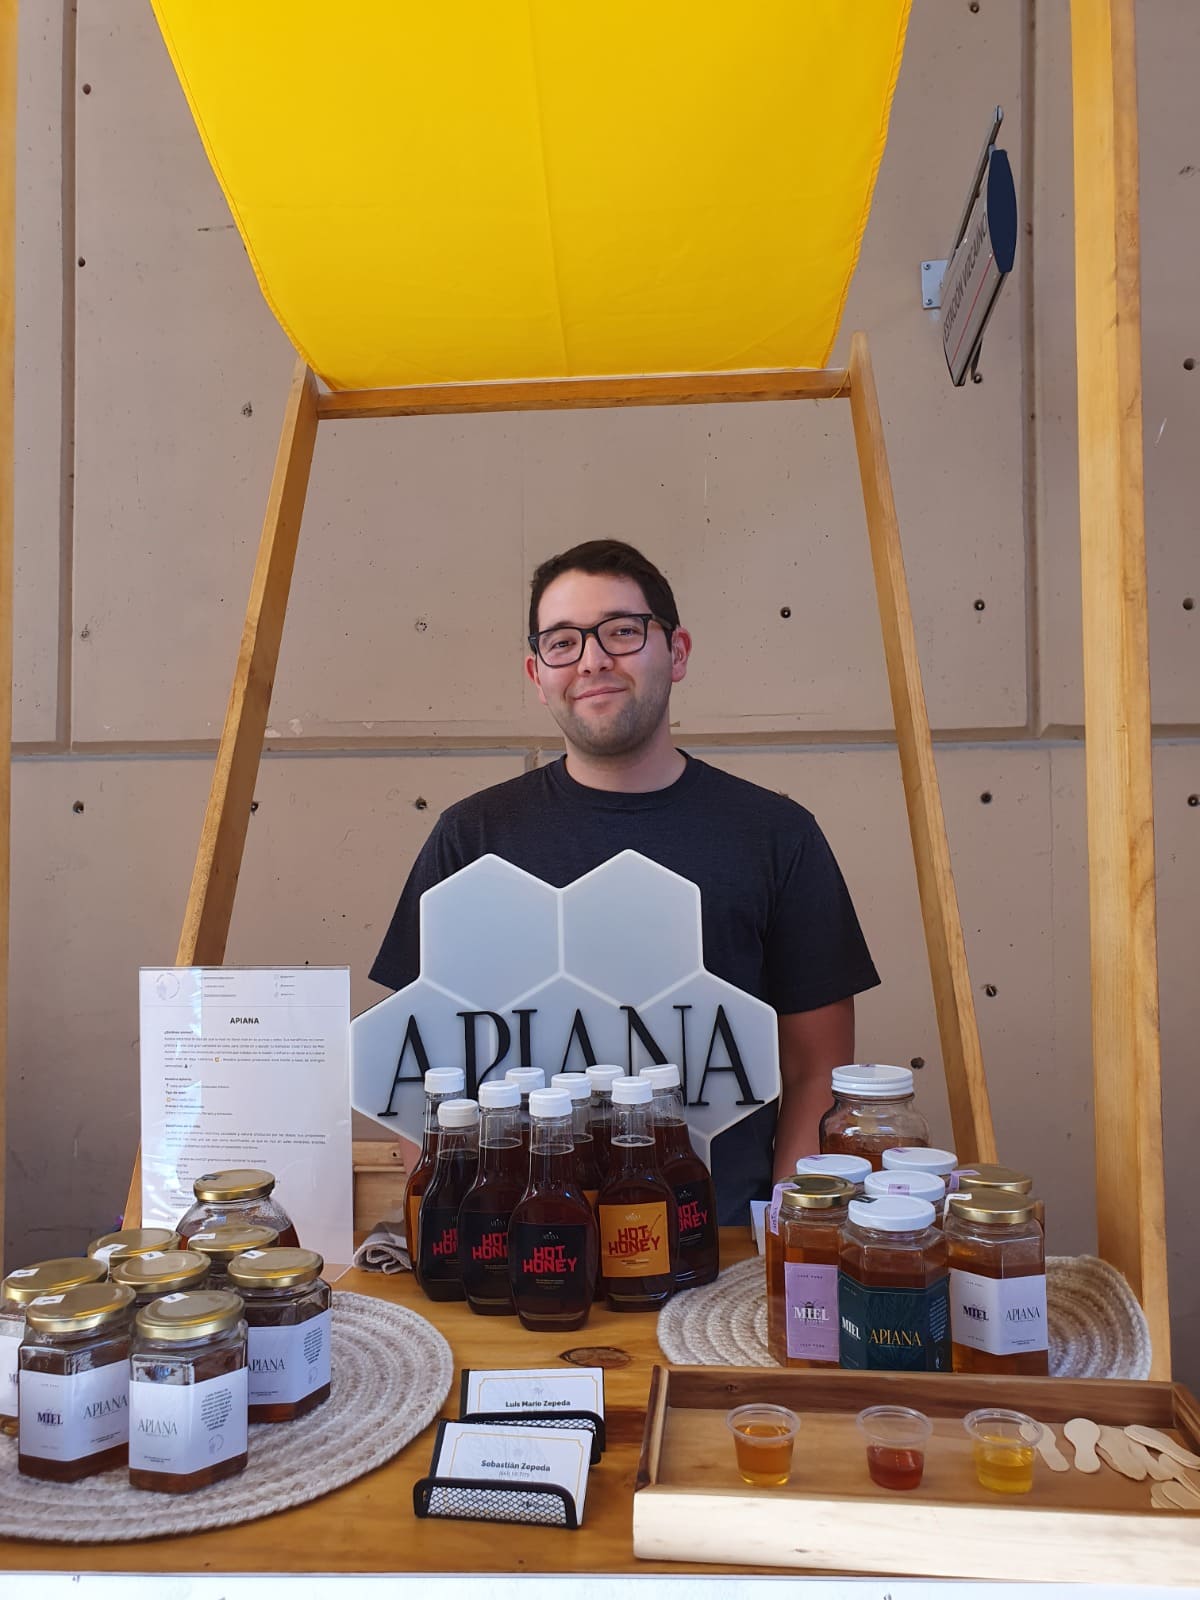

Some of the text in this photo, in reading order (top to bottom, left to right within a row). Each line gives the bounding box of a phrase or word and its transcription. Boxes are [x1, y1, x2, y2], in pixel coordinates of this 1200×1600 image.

[229, 1017, 260, 1025] APIANA
[377, 1004, 765, 1116] APIANA
[617, 1224, 649, 1242] HOT
[472, 1245, 509, 1260] HON
[532, 1245, 567, 1261] HOT
[608, 1236, 661, 1256] HONEY
[522, 1257, 577, 1274] HONEY
[794, 1307, 829, 1321] MIEL
[962, 1305, 1041, 1321] MIEL APIANA
[841, 1316, 923, 1347] MIEL APIANA
[37, 1394, 128, 1425] MIEL APIANA
[505, 1399, 571, 1408] Luis Mario Zepeda
[138, 1418, 178, 1436] APIANA
[481, 1459, 551, 1473] Sebastián Zepeda
